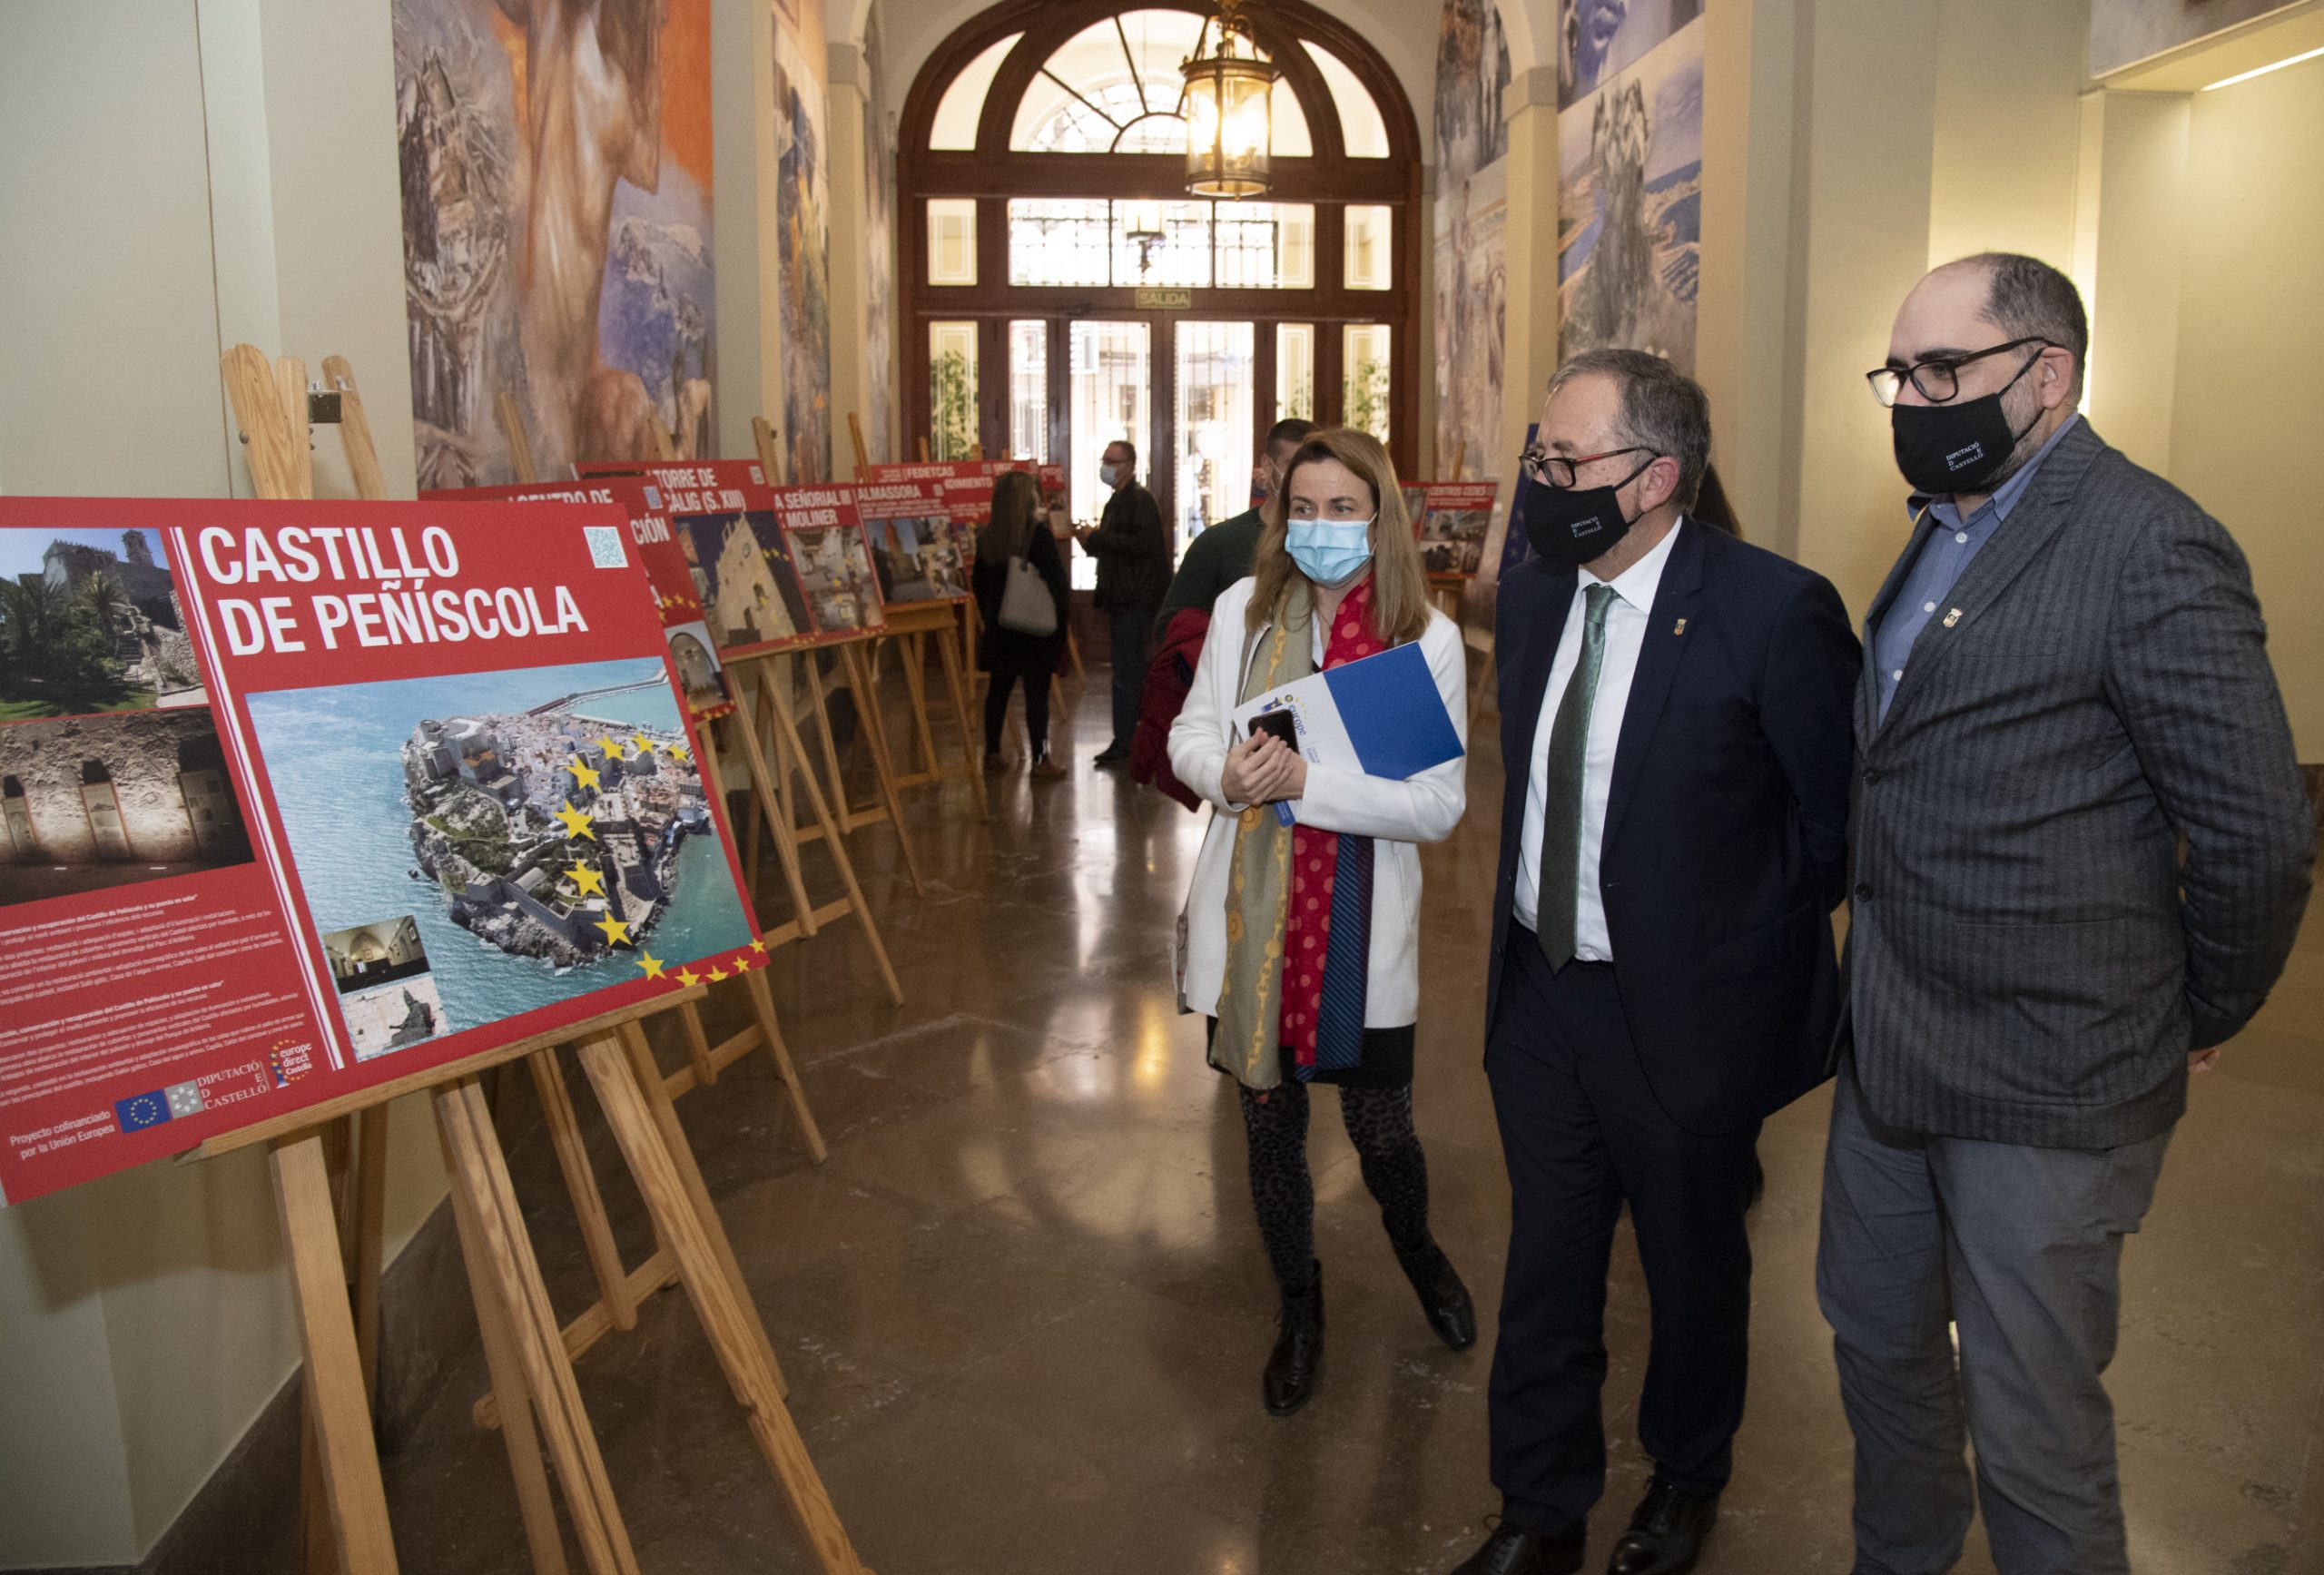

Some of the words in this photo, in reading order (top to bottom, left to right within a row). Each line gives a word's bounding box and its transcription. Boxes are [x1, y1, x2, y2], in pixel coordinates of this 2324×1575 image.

[1140, 293, 1188, 305] SALIDA
[652, 468, 699, 489] TORRE
[696, 468, 718, 487] DE
[944, 477, 993, 490] DIMIENTO
[784, 488, 842, 509] SEÑORIAL
[857, 484, 923, 502] ALMASSORA
[785, 508, 839, 529] MOLINER
[199, 527, 460, 584] CASTILLO
[217, 596, 306, 656] DE
[311, 579, 590, 649] PEÑÍSCOLA
[281, 1043, 312, 1058] europe
[283, 1054, 309, 1068] direct
[197, 1060, 260, 1088] DIPUTACIÓ
[201, 1088, 211, 1098] D
[255, 1073, 263, 1083] E
[204, 1082, 267, 1110] CASTELLÓ
[10, 1127, 53, 1146] Proyecto
[54, 1110, 111, 1134] cofinanciado
[21, 1147, 36, 1160] por
[38, 1144, 48, 1153] la
[49, 1135, 76, 1149] Unión
[77, 1125, 115, 1142] Europea
